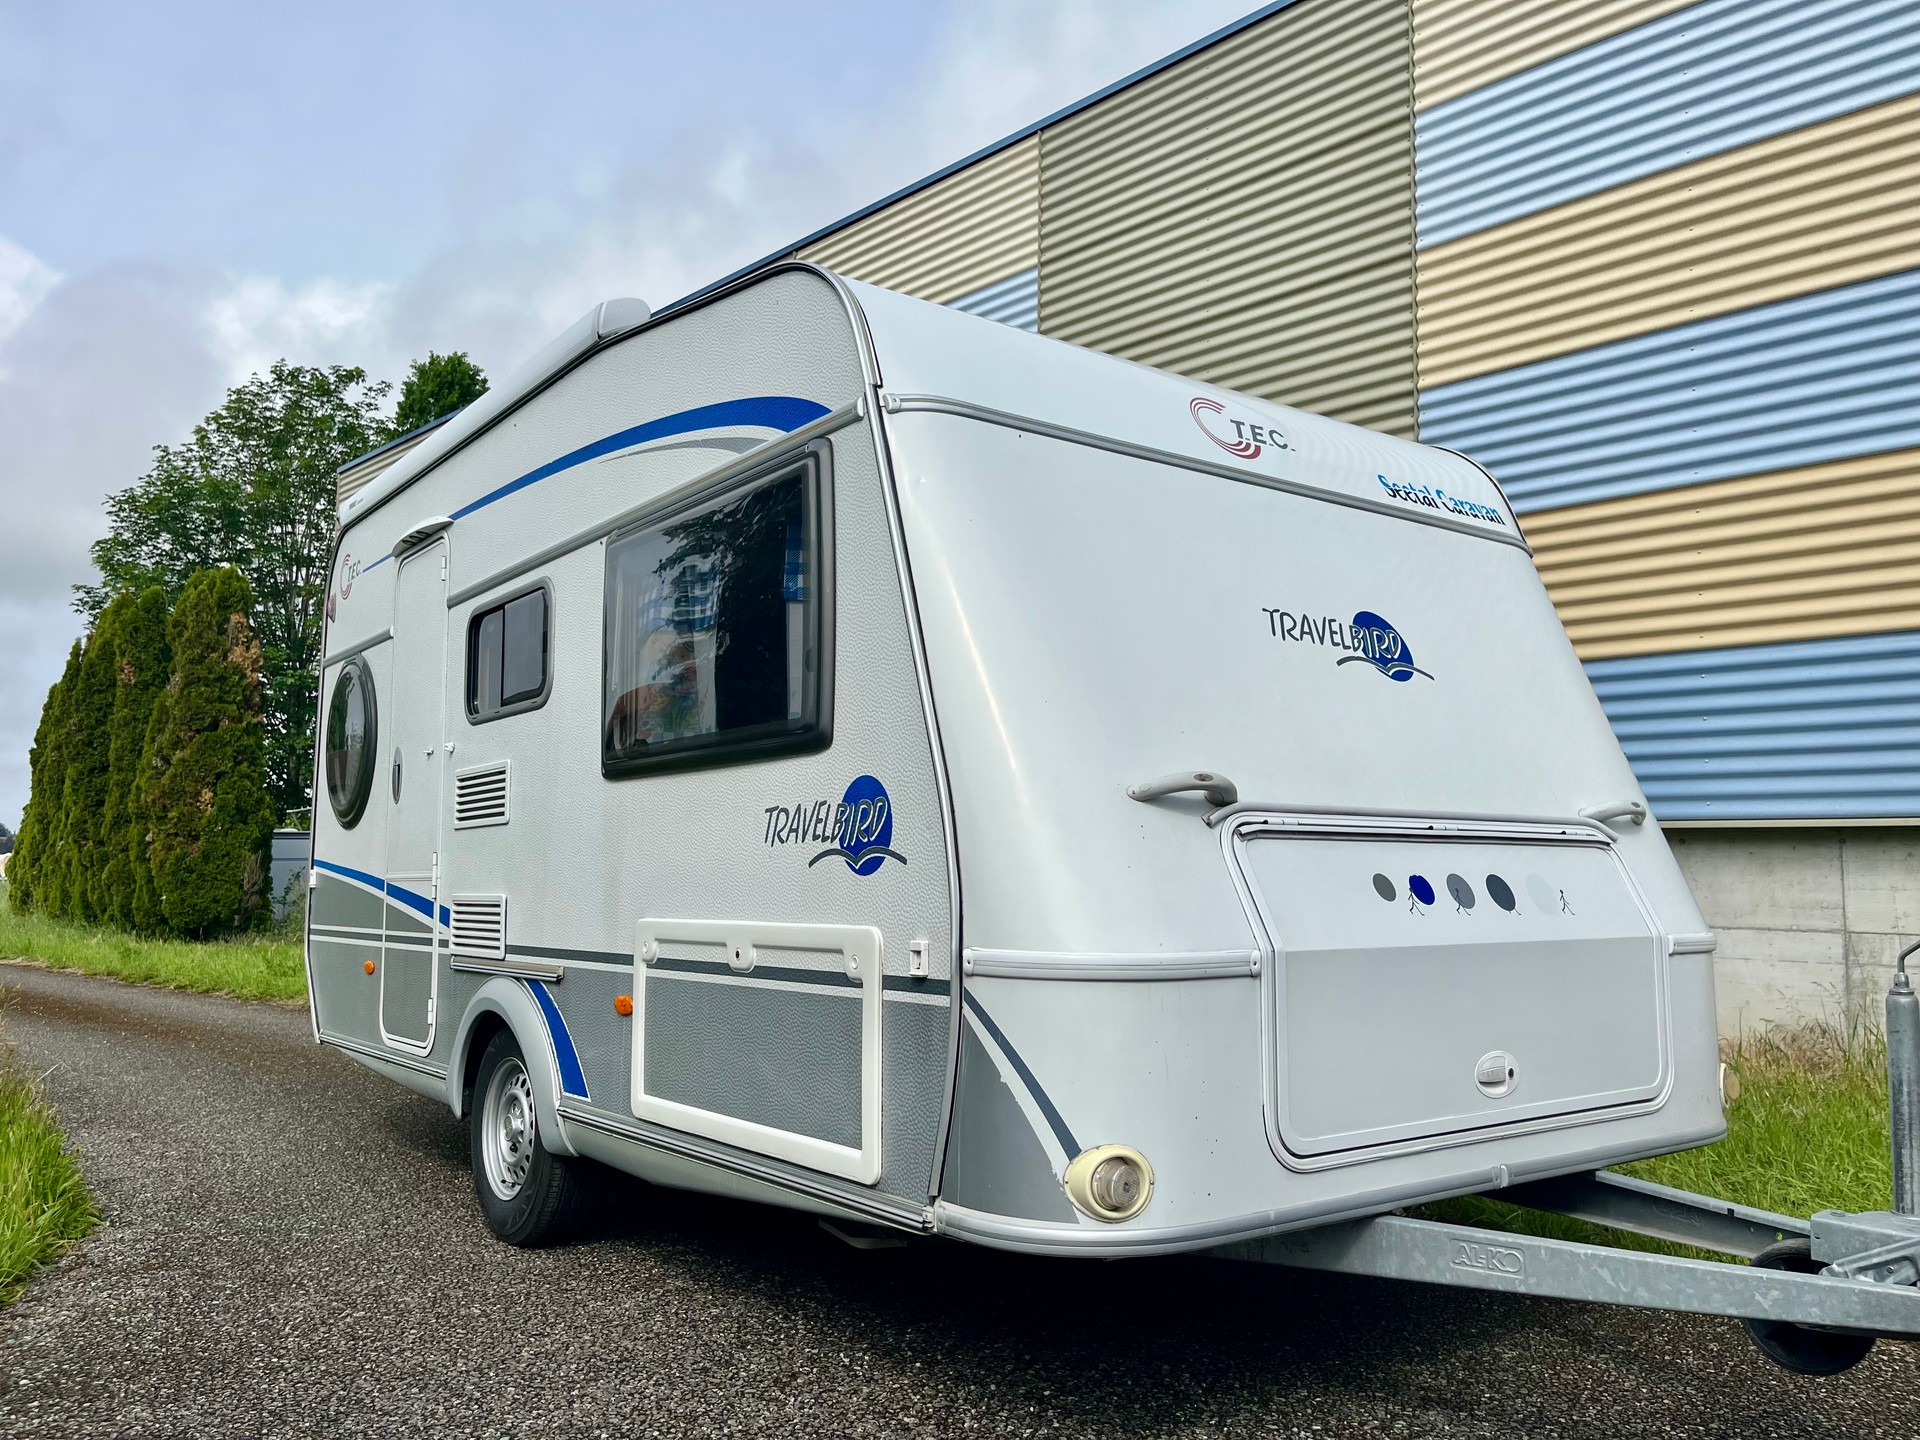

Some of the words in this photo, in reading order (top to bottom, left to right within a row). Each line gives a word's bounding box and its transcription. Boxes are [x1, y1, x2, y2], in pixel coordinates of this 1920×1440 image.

[1435, 489, 1507, 526] Caravan
[1261, 607, 1402, 660] TRAVELBIRD
[764, 796, 888, 848] TRAVELBIRD
